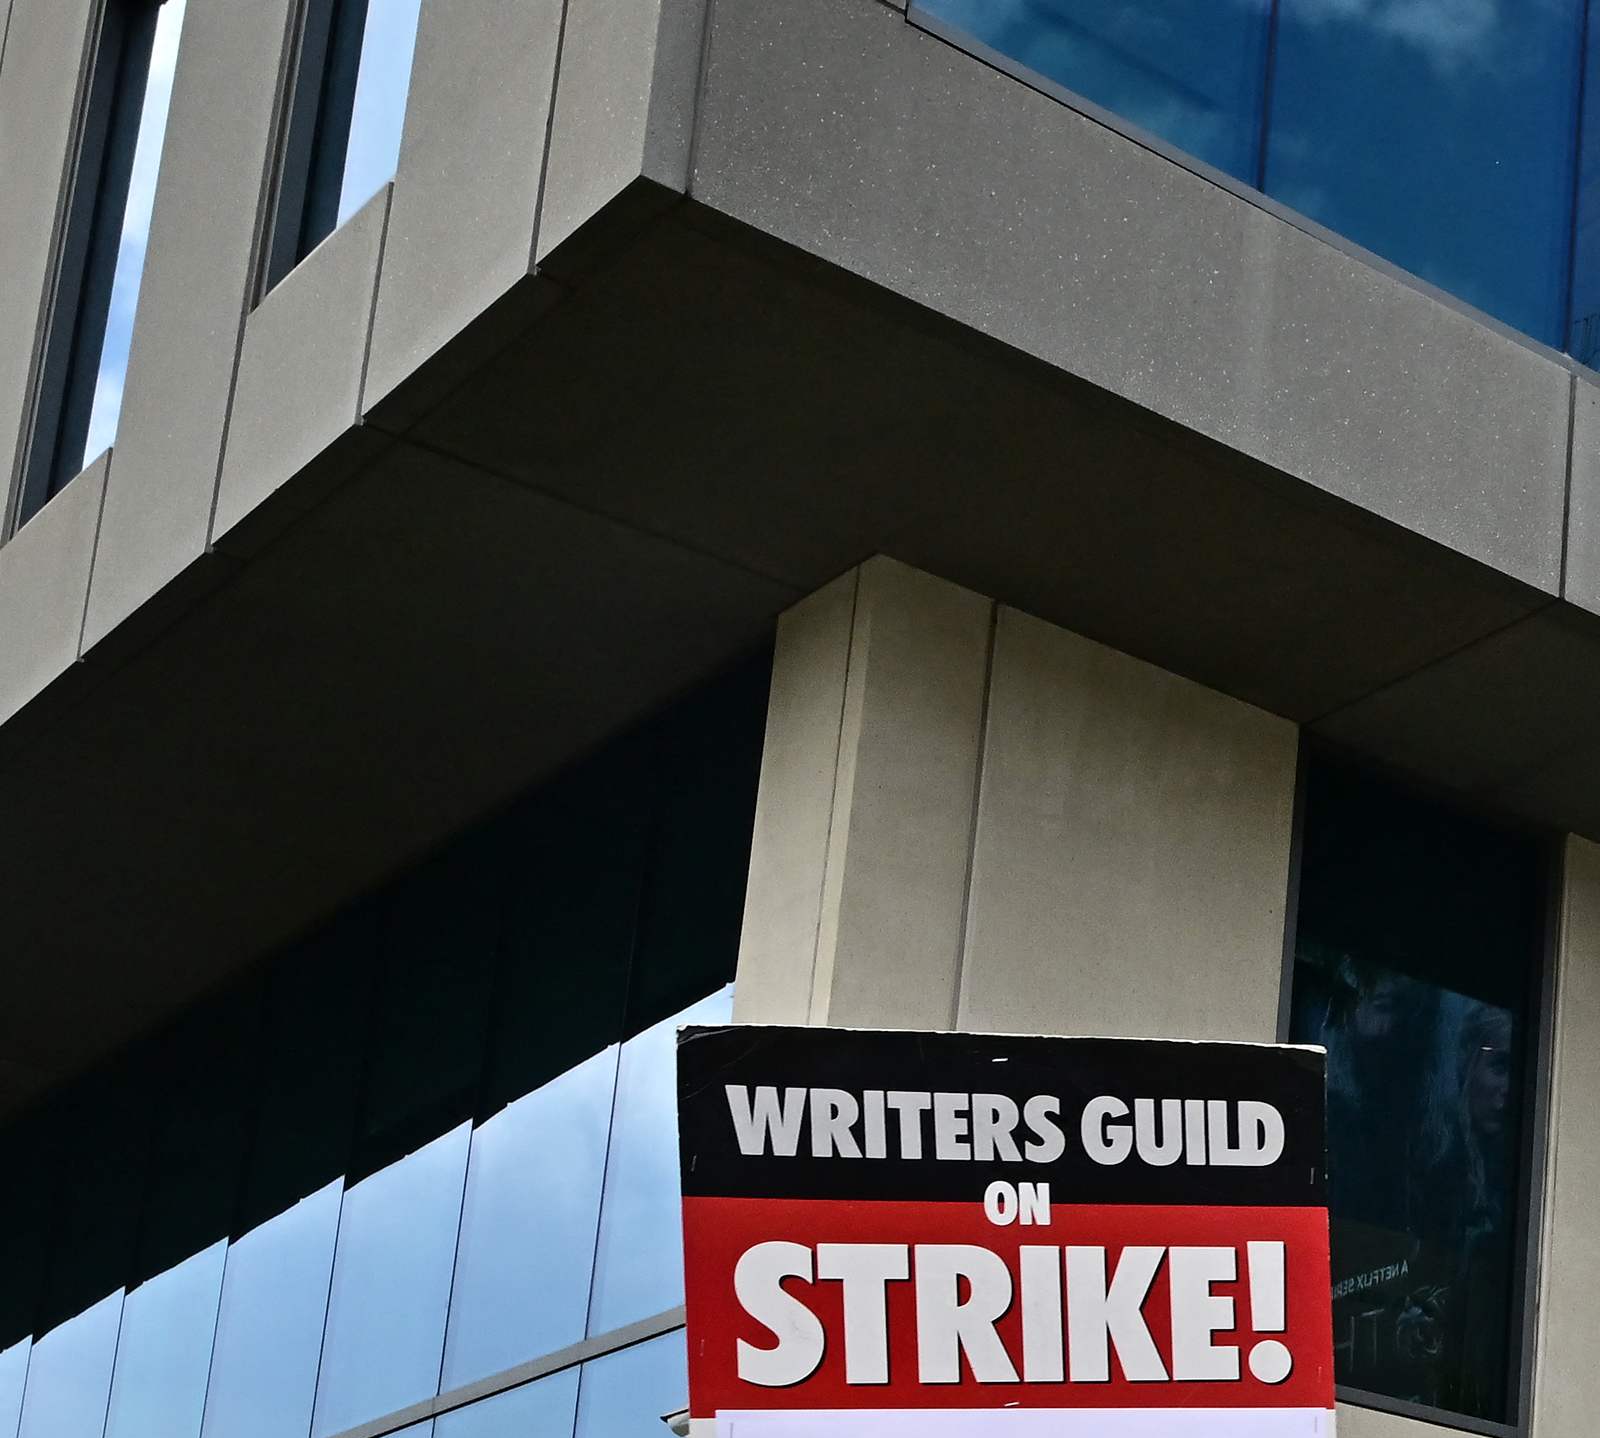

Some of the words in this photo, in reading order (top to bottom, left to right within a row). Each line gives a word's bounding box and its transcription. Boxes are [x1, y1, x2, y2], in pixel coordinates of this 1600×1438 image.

[725, 1084, 1066, 1162] WRITERS
[1081, 1096, 1286, 1167] GUILD
[984, 1181, 1051, 1226] ON
[733, 1239, 1294, 1388] STRIKE!
